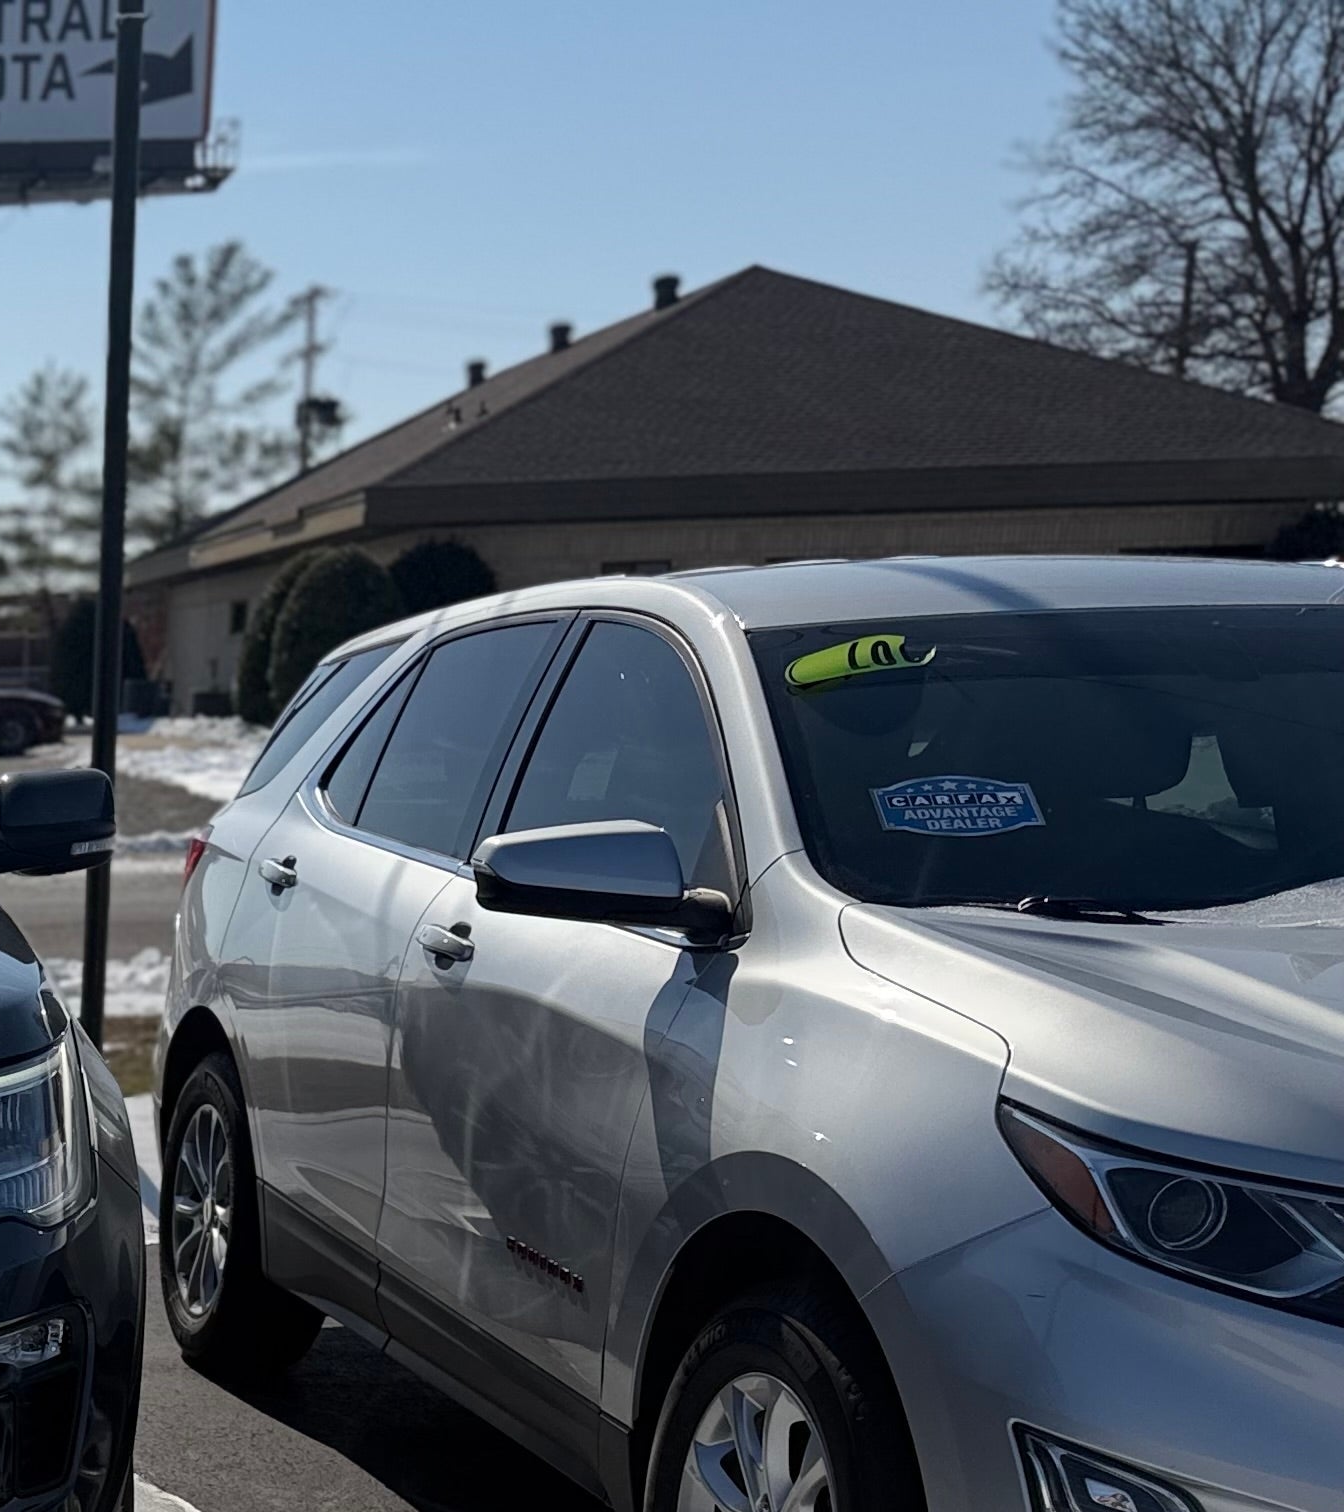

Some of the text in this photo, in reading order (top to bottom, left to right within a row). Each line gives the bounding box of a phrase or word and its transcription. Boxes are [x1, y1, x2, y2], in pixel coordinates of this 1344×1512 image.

[889, 792, 1021, 807] CARFAX
[903, 806, 1019, 820] ADVANTAGE
[926, 817, 1003, 831] DEALER
